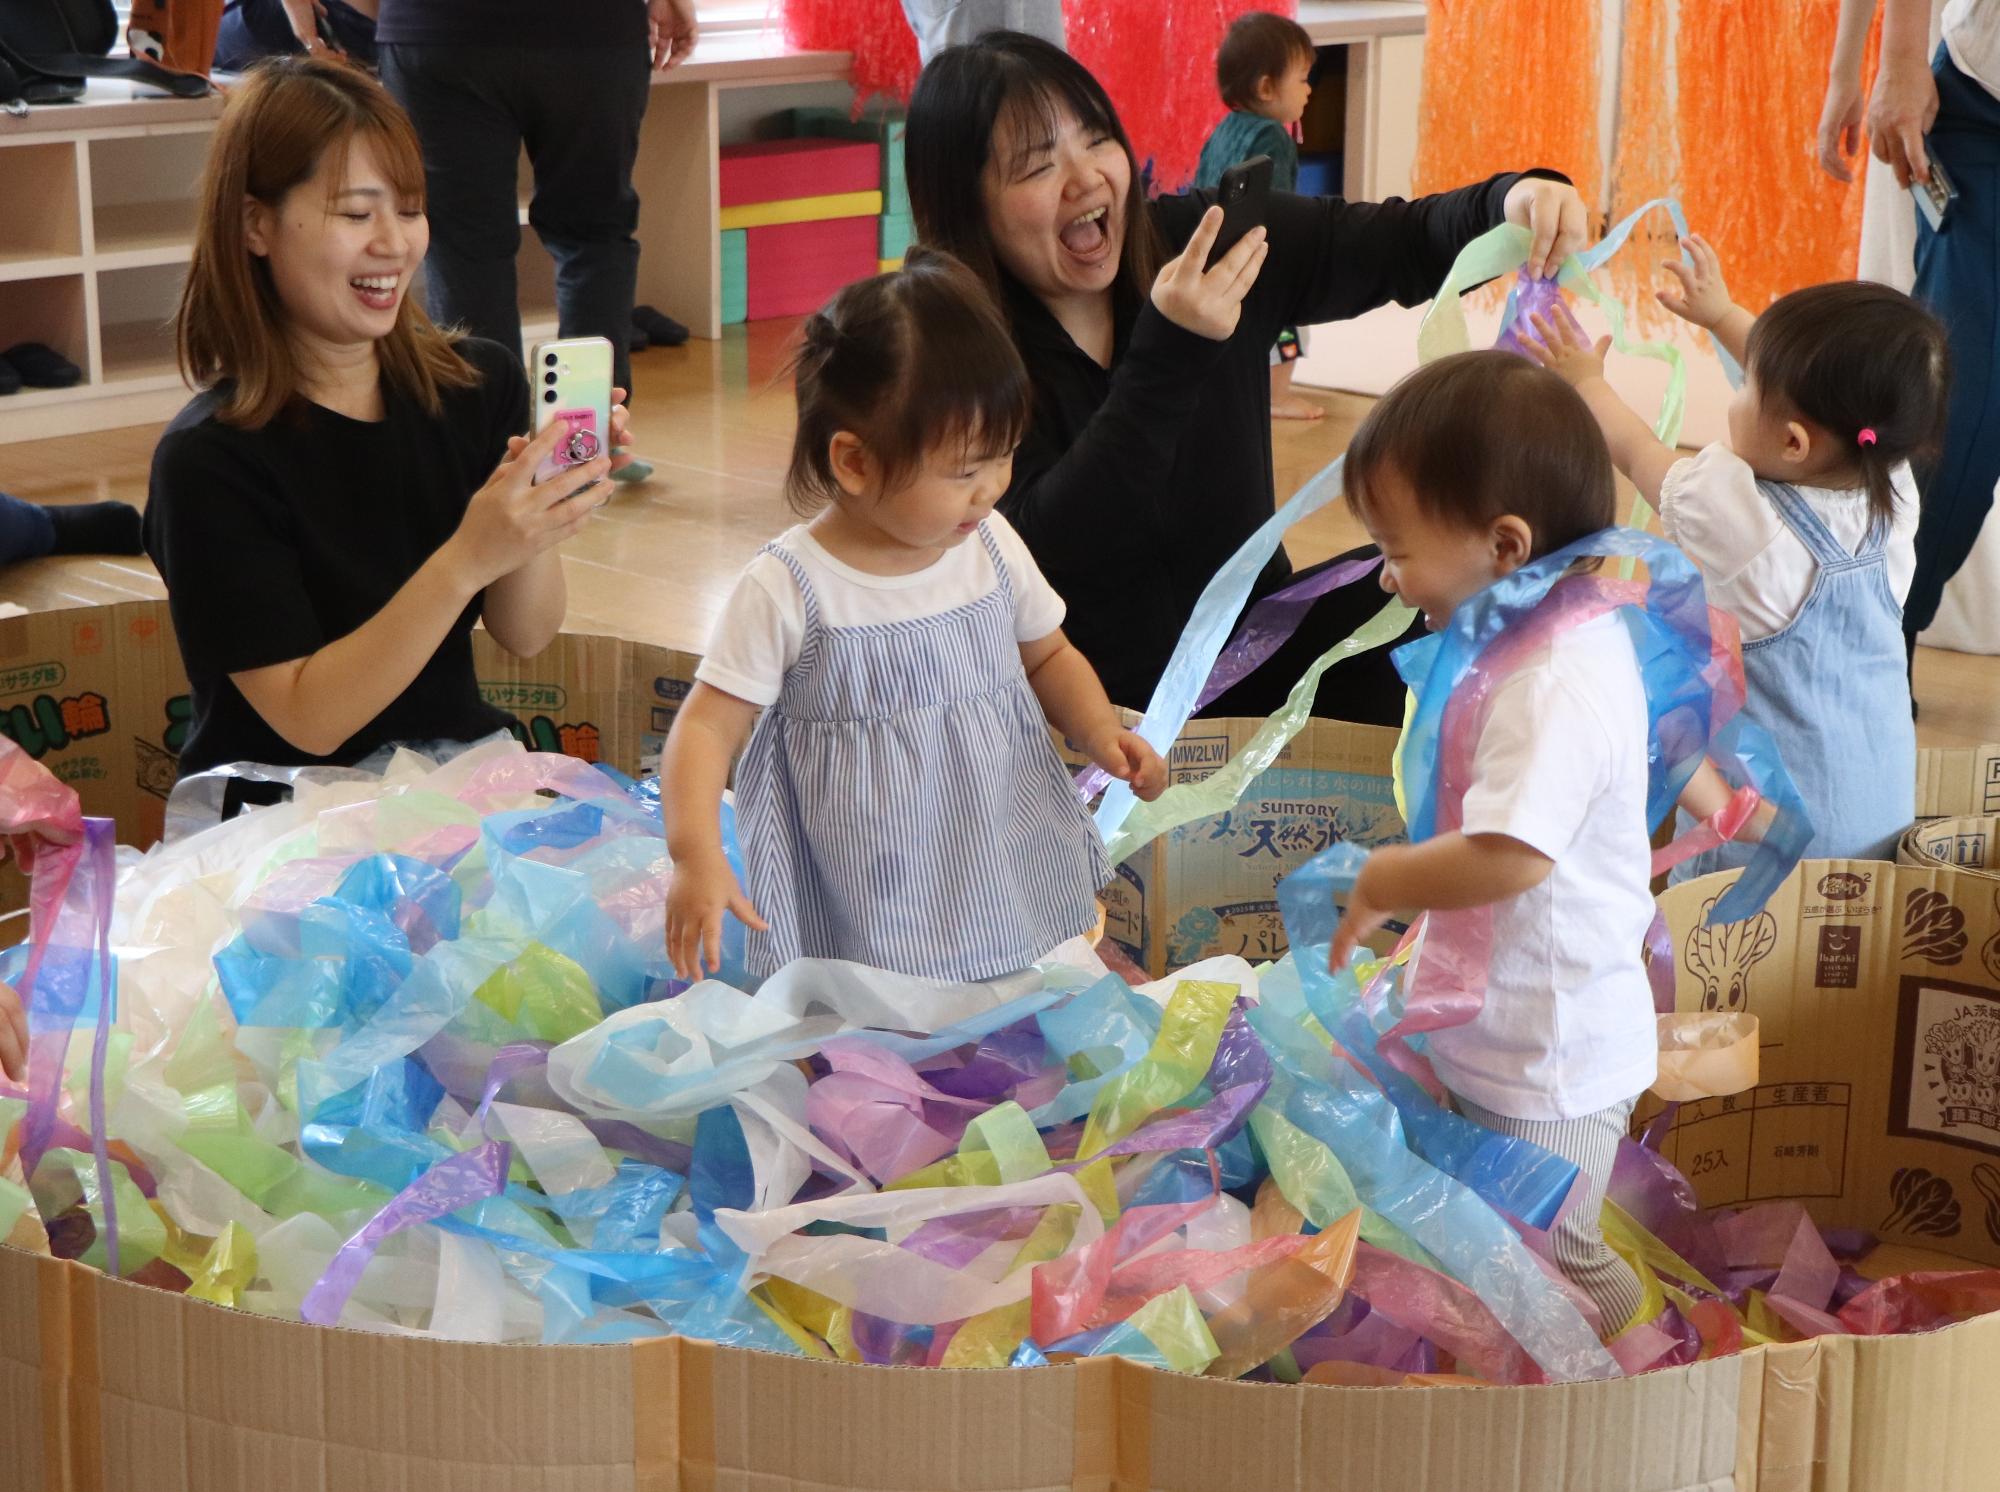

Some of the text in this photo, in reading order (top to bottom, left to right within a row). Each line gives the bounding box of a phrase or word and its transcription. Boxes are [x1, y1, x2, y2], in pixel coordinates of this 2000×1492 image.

[0, 691, 111, 760] い輪
[1173, 744, 1224, 764] MW2LW
[1260, 802, 1339, 817] SUNTORY
[1239, 819, 1347, 858] 天然水
[1819, 953, 1856, 963] Ibaraki
[1773, 1086, 1830, 1103] 生産者
[1691, 1151, 1729, 1176] 25入
